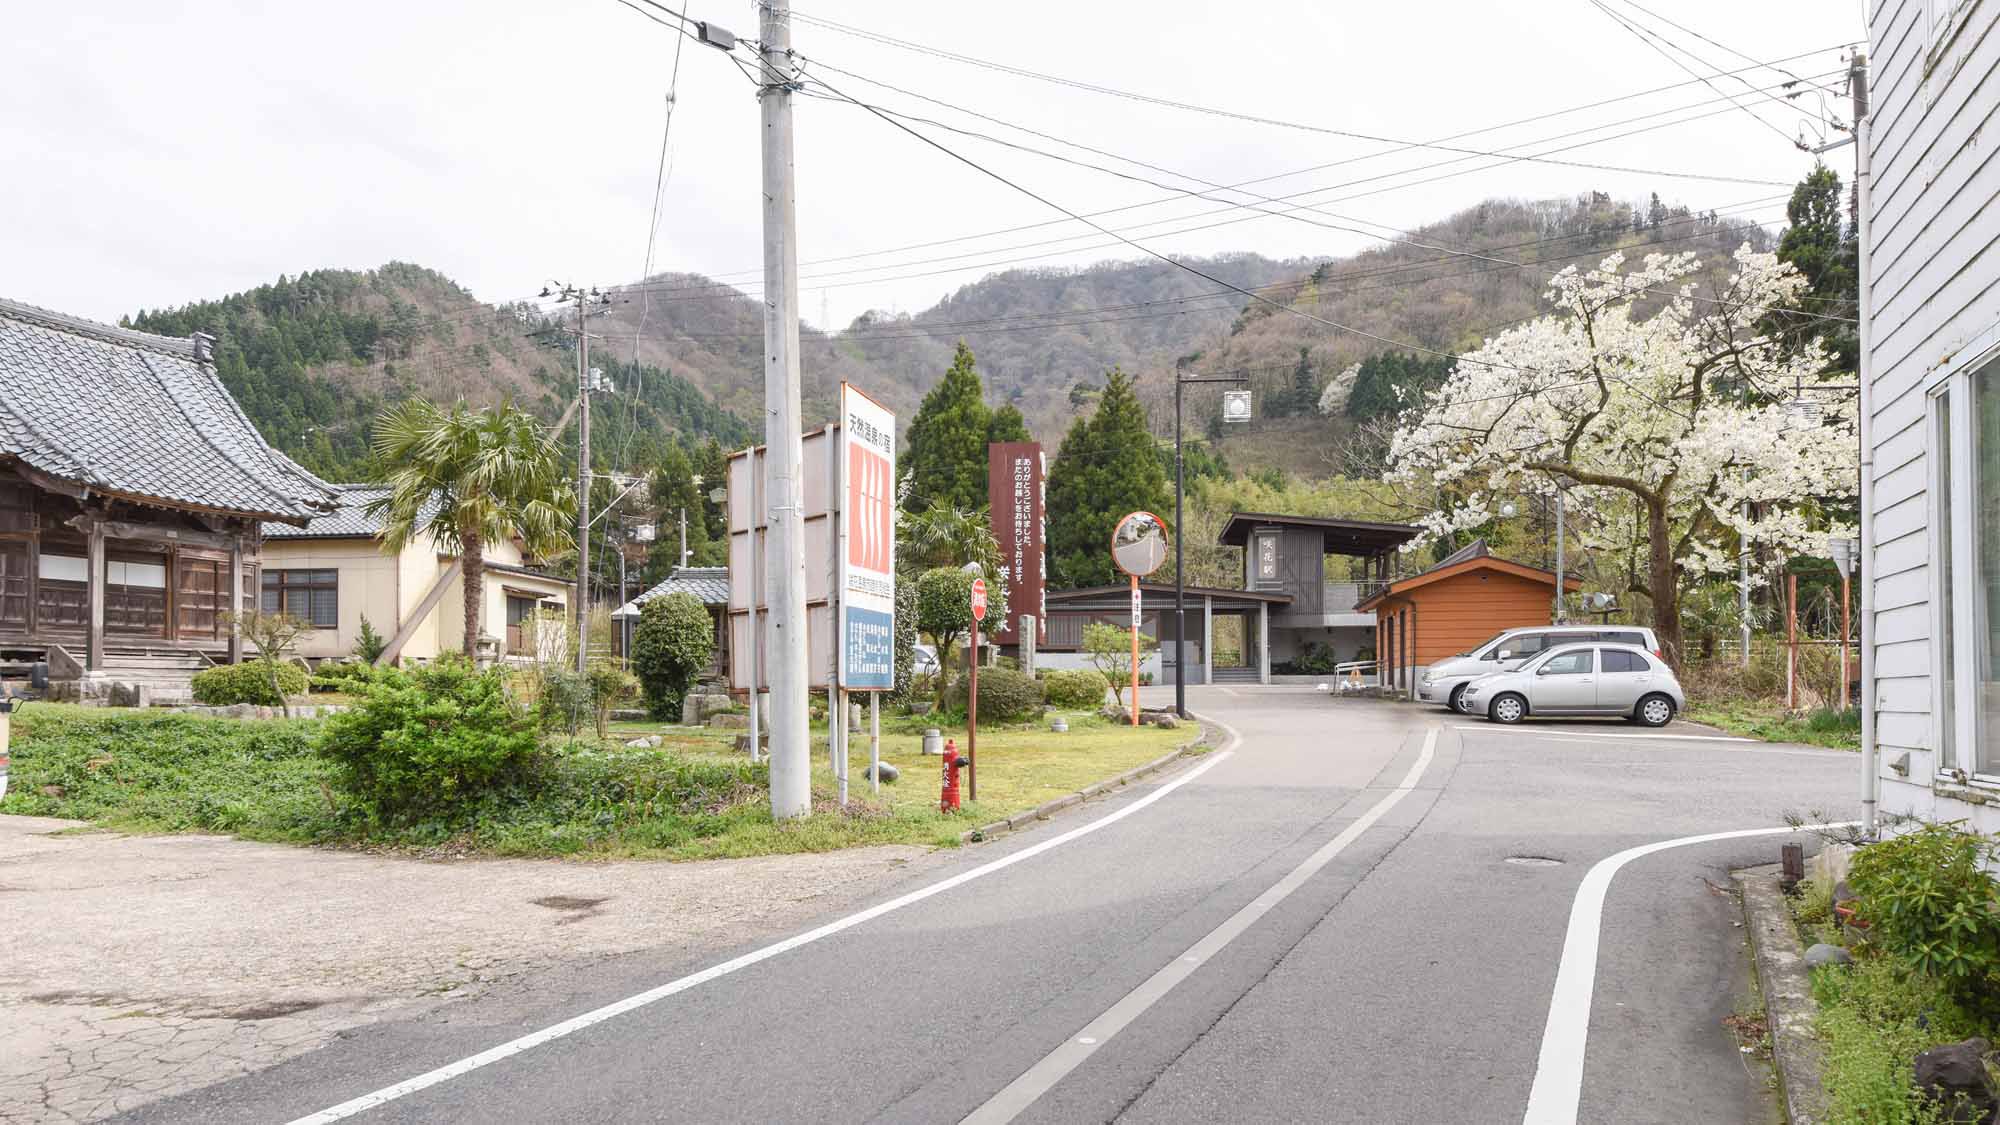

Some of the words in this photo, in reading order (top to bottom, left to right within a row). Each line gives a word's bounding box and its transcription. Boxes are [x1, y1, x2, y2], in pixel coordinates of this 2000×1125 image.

[849, 412, 891, 454] 天然温泉の宿
[1014, 458, 1023, 585] またのお越しをお待ちしております。
[1023, 458, 1032, 547] ありがとうございました。
